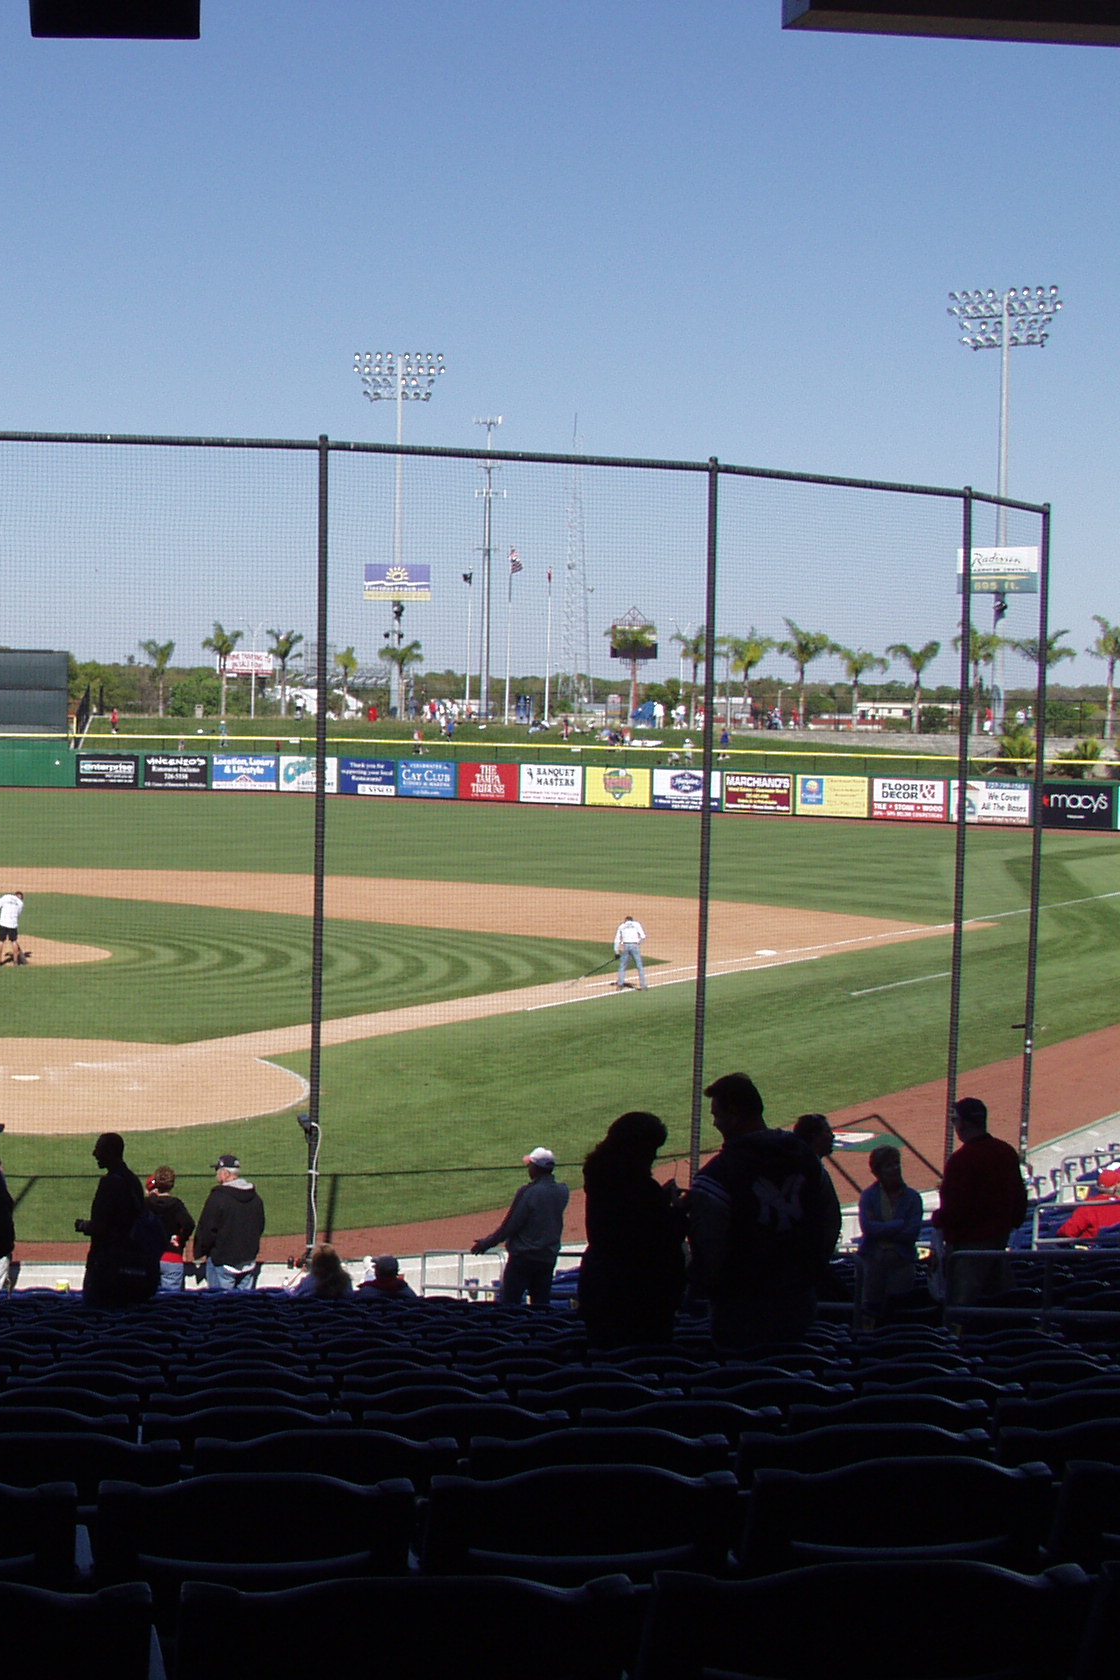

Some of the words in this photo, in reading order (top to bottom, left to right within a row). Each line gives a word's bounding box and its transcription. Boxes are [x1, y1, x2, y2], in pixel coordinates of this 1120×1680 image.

[480, 764, 497, 775] THE
[536, 767, 575, 778] BANQUET
[475, 773, 501, 784] TAMPA
[536, 777, 575, 787] MASTERS
[726, 775, 790, 789] MARCHIANO'S
[471, 783, 505, 794] TRIBUNE
[882, 782, 918, 792] FLOOR
[920, 784, 935, 801] &
[882, 791, 918, 800] DECOR
[988, 792, 999, 801] We
[1001, 793, 1021, 802] Cover
[981, 802, 991, 810] All
[993, 803, 1005, 811] The
[1007, 803, 1027, 813] Bases
[1050, 793, 1108, 813] macy's
[922, 805, 943, 813] WOOD
